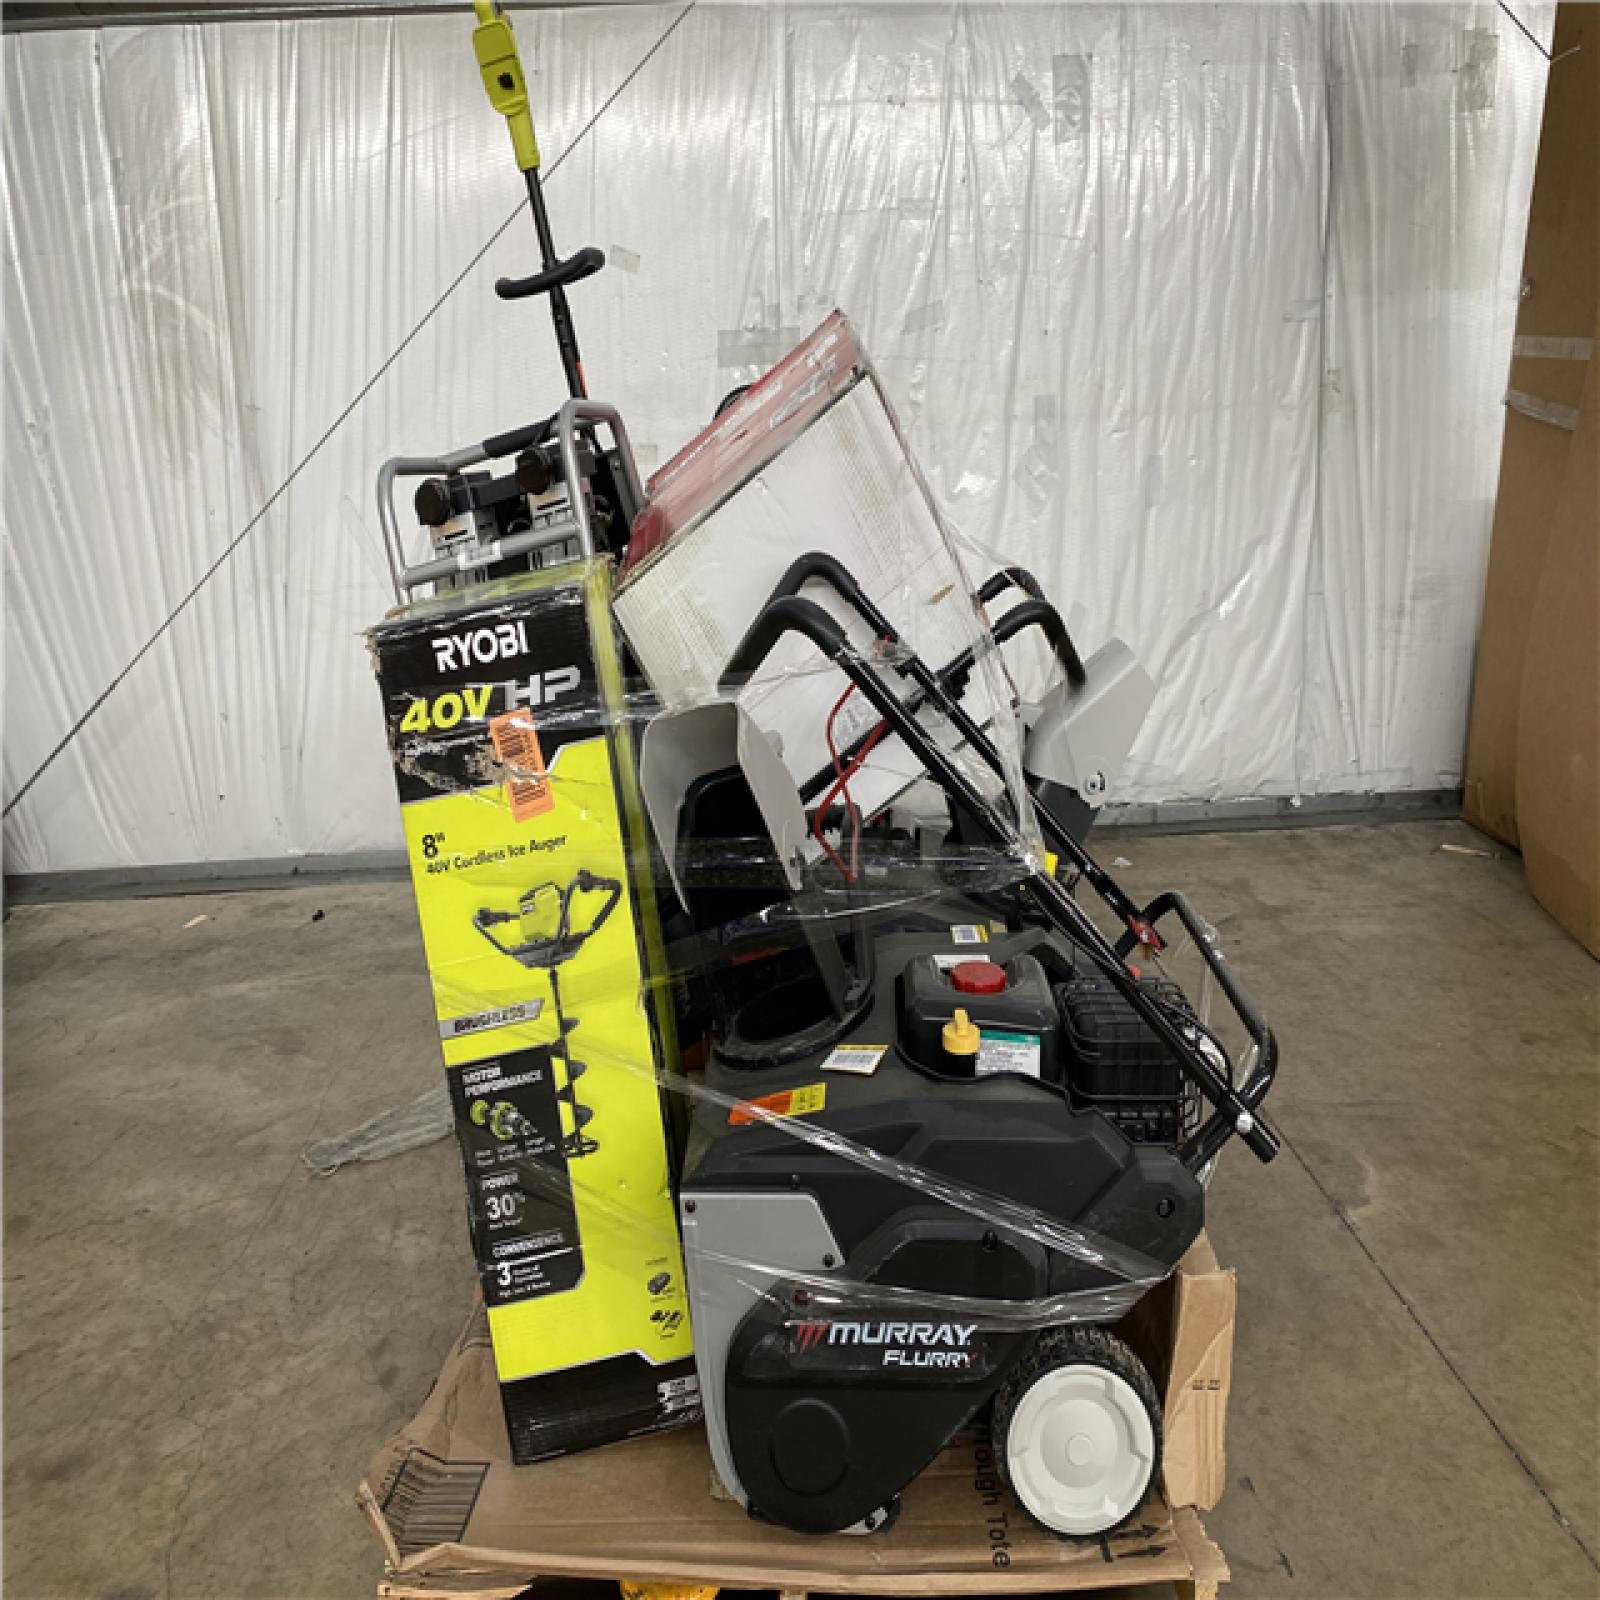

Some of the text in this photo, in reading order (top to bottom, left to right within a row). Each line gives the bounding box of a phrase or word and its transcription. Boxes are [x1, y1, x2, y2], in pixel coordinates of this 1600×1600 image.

[431, 621, 530, 673] RYOBI
[400, 665, 581, 733] 40V HP
[454, 850, 506, 870] Cordless
[507, 844, 526, 858] Ice
[530, 835, 567, 853] Auger
[827, 1322, 978, 1346] MURRAY
[986, 1512, 1013, 1568] Tote
